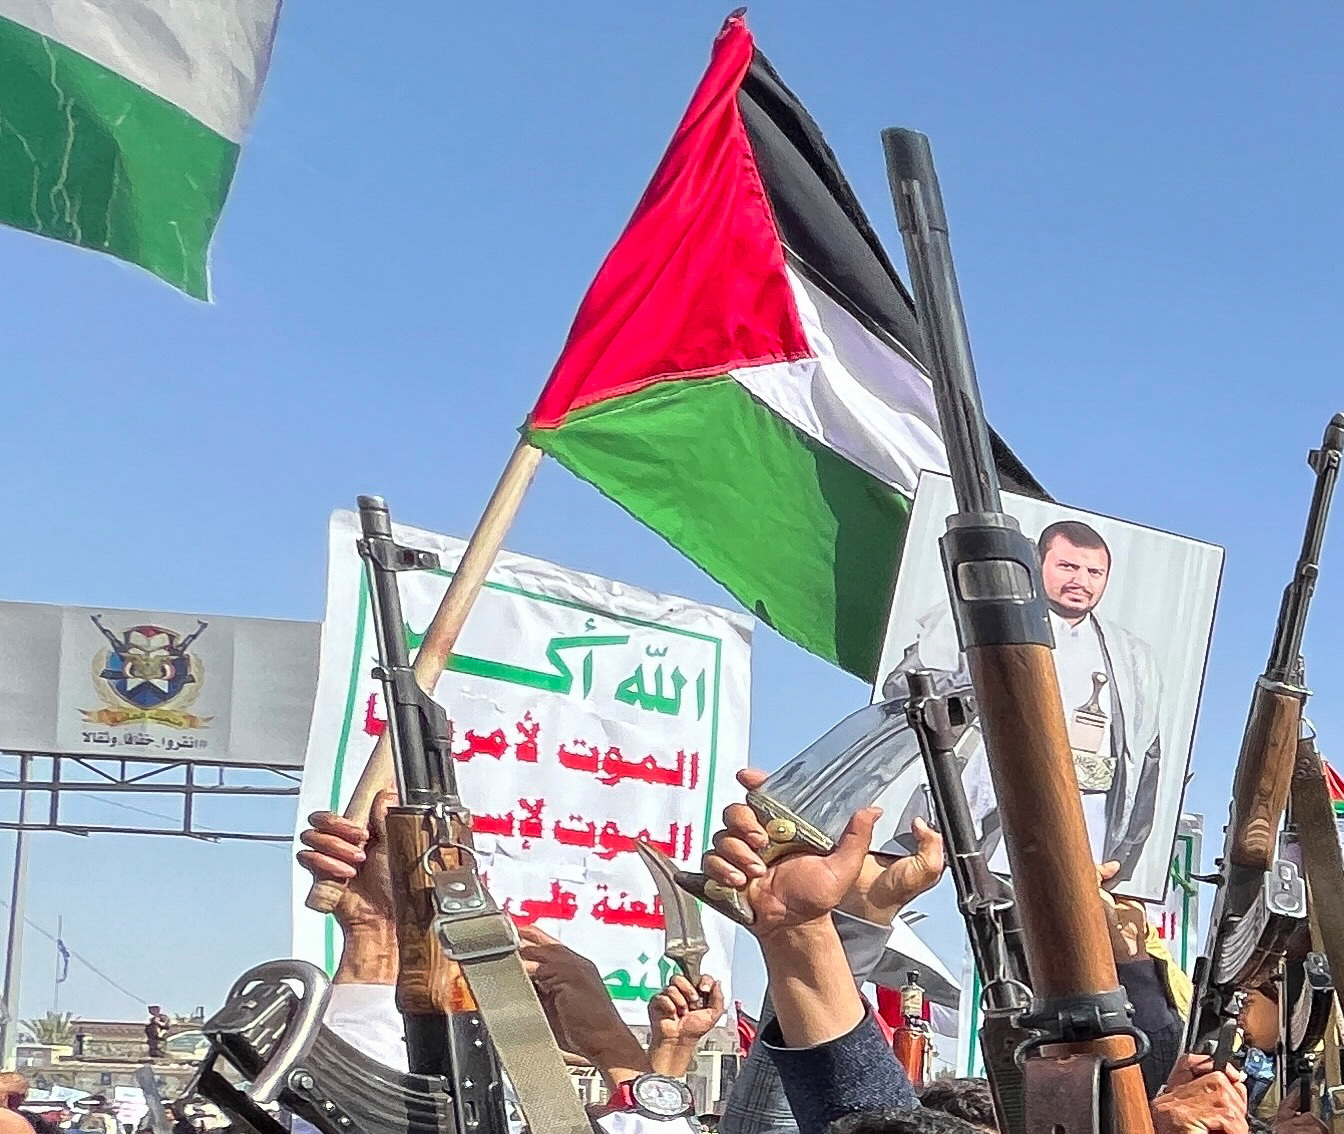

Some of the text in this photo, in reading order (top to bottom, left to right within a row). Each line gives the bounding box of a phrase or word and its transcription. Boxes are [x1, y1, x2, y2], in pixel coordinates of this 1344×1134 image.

[615, 644, 705, 721] الله
[364, 692, 699, 789] الموت لأمرا
[554, 815, 692, 861] الموت
